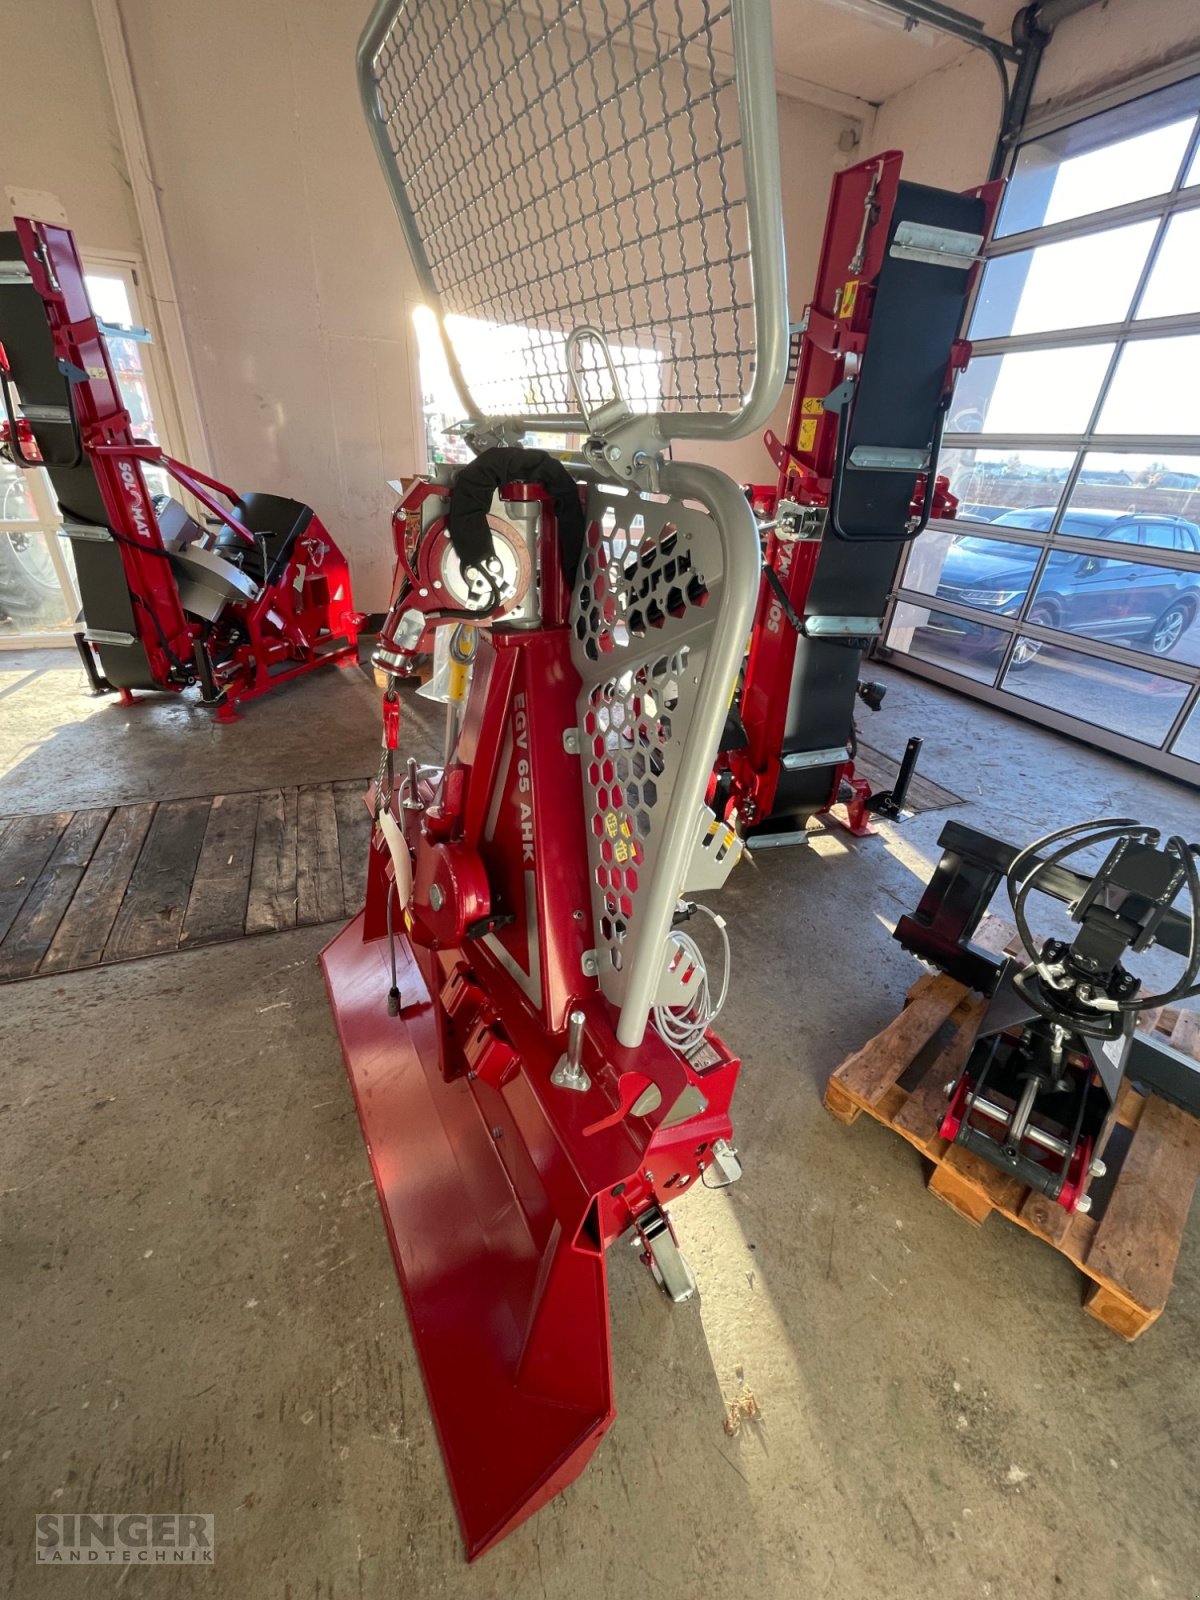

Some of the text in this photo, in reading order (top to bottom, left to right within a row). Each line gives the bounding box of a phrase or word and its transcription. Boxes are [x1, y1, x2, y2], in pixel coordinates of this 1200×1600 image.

[617, 548, 692, 611] TAJFUN
[514, 692, 535, 863] EGV 65 AHK
